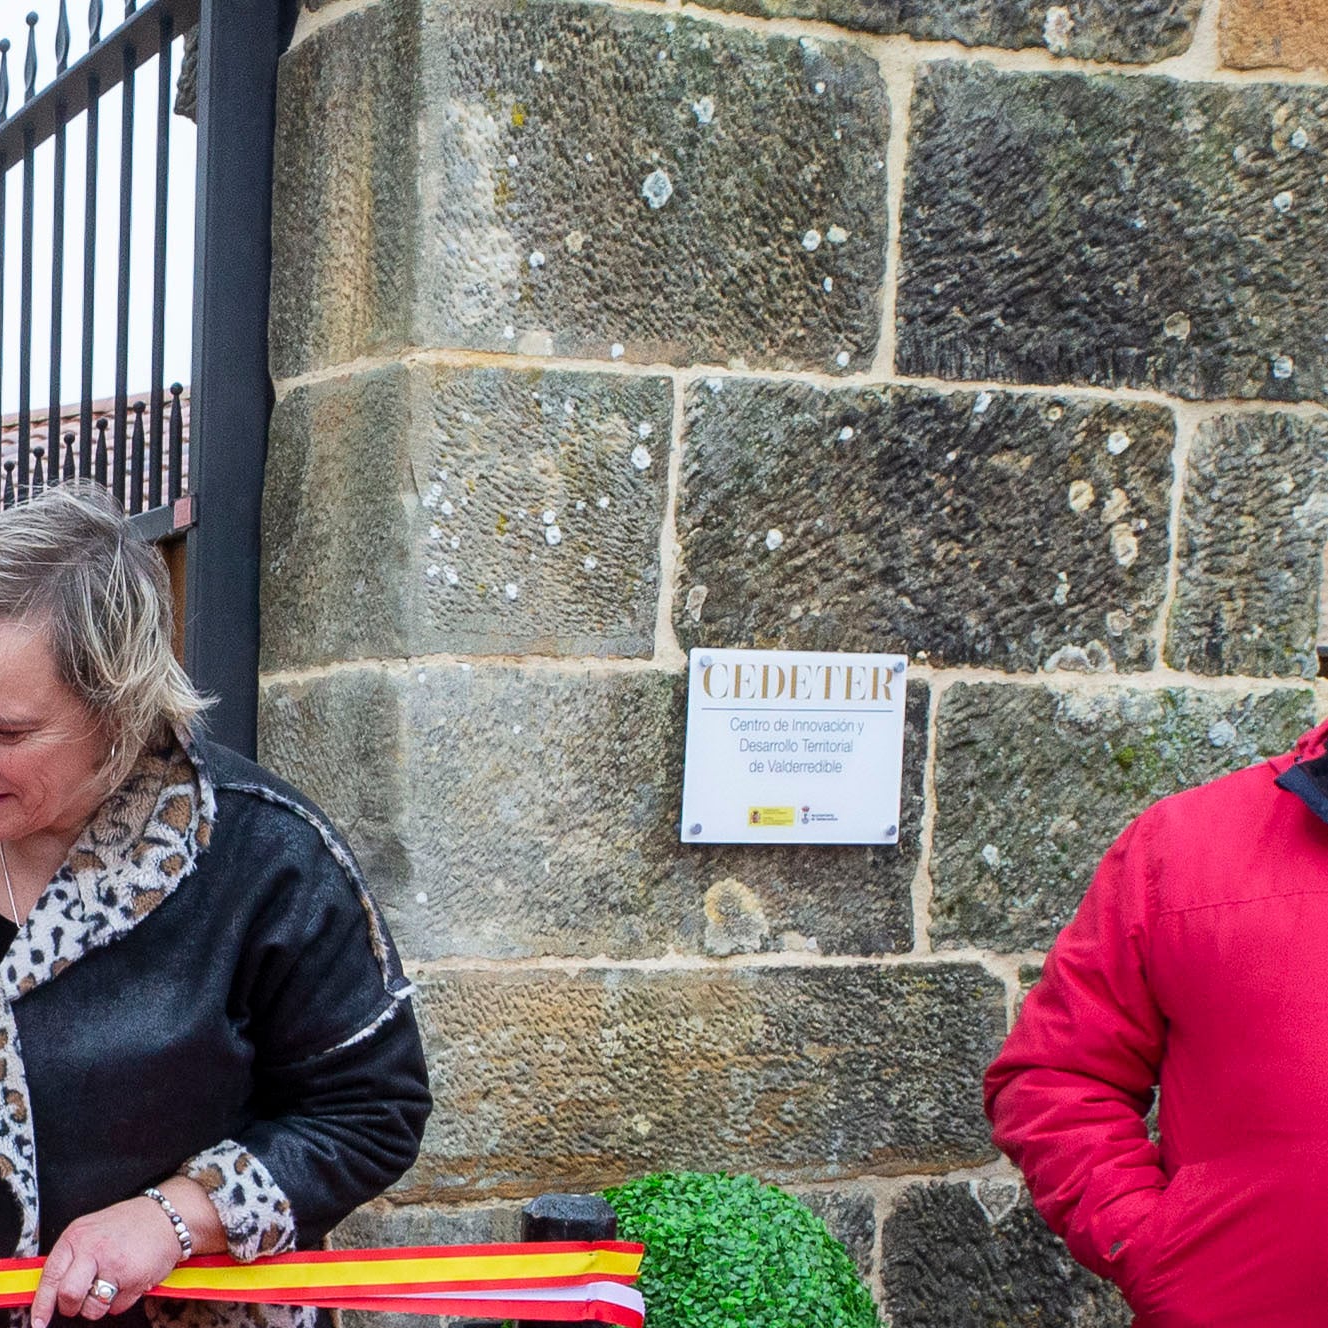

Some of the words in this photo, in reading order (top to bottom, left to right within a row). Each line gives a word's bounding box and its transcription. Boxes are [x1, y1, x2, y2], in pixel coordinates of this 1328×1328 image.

[703, 663, 893, 700] CEDETER
[730, 716, 771, 732] Centro
[773, 718, 789, 732] de
[792, 718, 855, 733] Innovación
[857, 722, 865, 735] y
[739, 738, 799, 753] Desarrollo
[802, 738, 854, 753] Territorial
[749, 760, 765, 773] de
[767, 760, 843, 774] Valderredible
